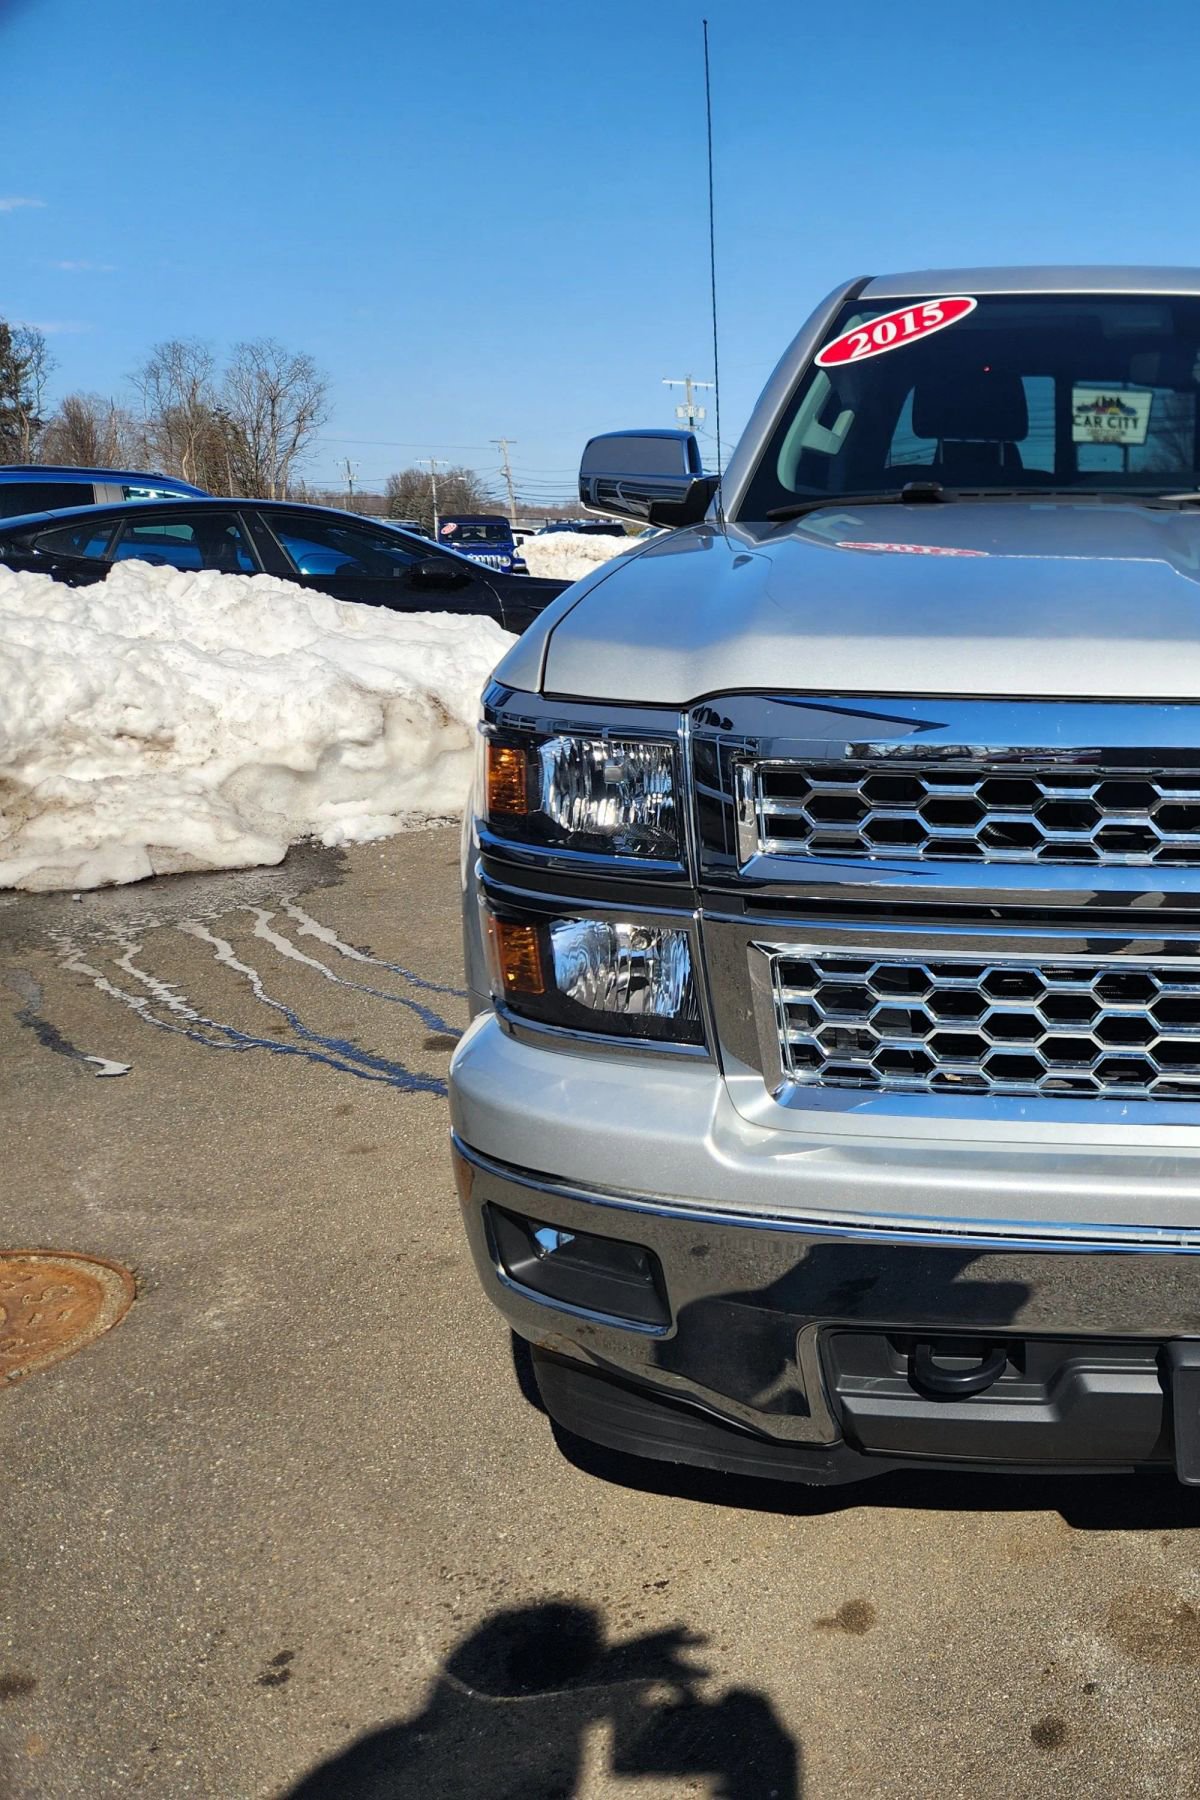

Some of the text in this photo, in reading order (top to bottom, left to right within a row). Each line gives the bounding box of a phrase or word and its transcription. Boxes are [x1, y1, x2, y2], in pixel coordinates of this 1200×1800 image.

[847, 302, 945, 359] 2015
[1073, 414, 1139, 430] CAR CITY
